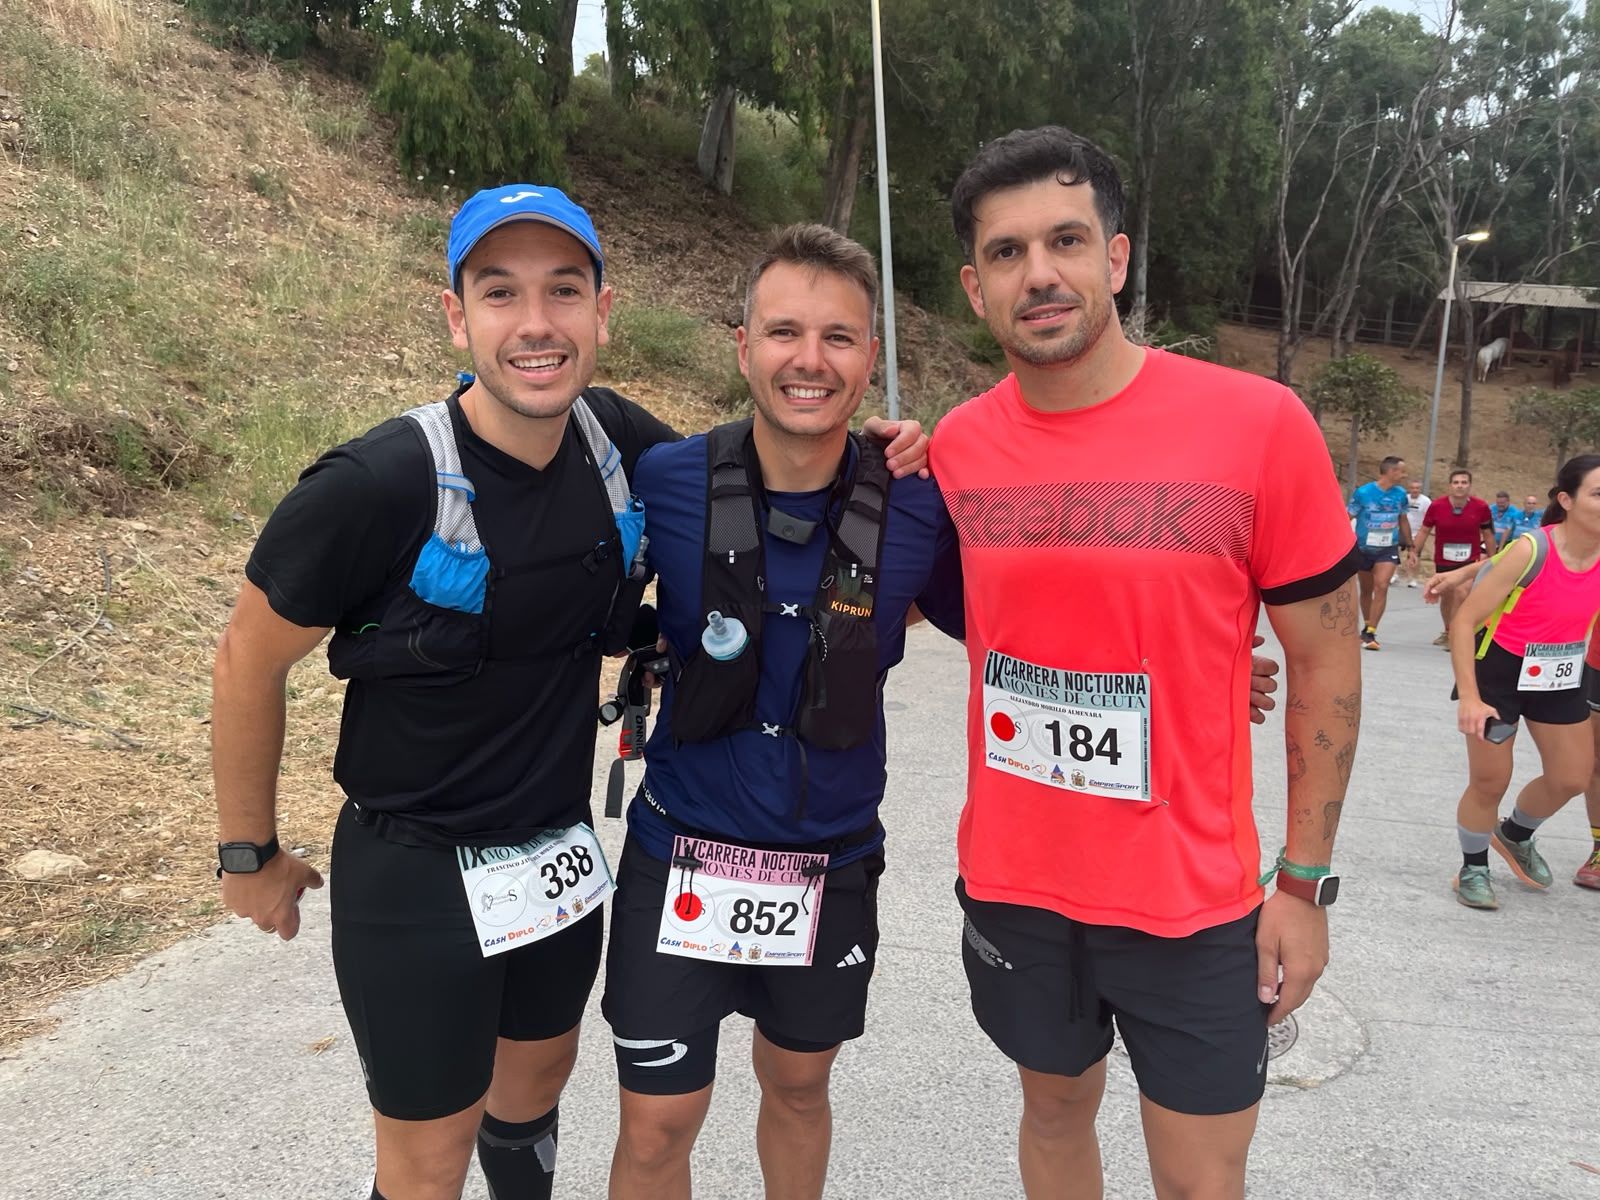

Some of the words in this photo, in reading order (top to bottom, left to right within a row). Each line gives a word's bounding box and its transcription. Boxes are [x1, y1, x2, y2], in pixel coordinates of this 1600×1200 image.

[831, 600, 872, 617] KIPRUN
[985, 651, 1005, 689] IX
[1004, 657, 1060, 689] CARRERA
[1064, 671, 1147, 695] NOCTURNA
[1556, 662, 1573, 678] 58
[1004, 677, 1058, 701] MONTES
[1064, 691, 1085, 705] DE
[1090, 693, 1146, 709] CEUTA
[1009, 694, 1040, 708] ALEJANDRO
[1040, 703, 1067, 714] MORILLO
[1068, 709, 1103, 719] ALMENARA
[1045, 720, 1122, 766] 184
[988, 751, 1007, 763] CASH
[1007, 757, 1031, 772] DIPLO
[698, 841, 756, 869] CARRERA
[487, 861, 520, 874] FRANCISCO
[540, 844, 594, 900] 338
[758, 870, 775, 882] DE
[729, 898, 800, 936] 852
[484, 935, 507, 947] CASH
[507, 927, 535, 941] DIPLO
[660, 936, 682, 948] CASH
[682, 940, 708, 952] DIPLO
